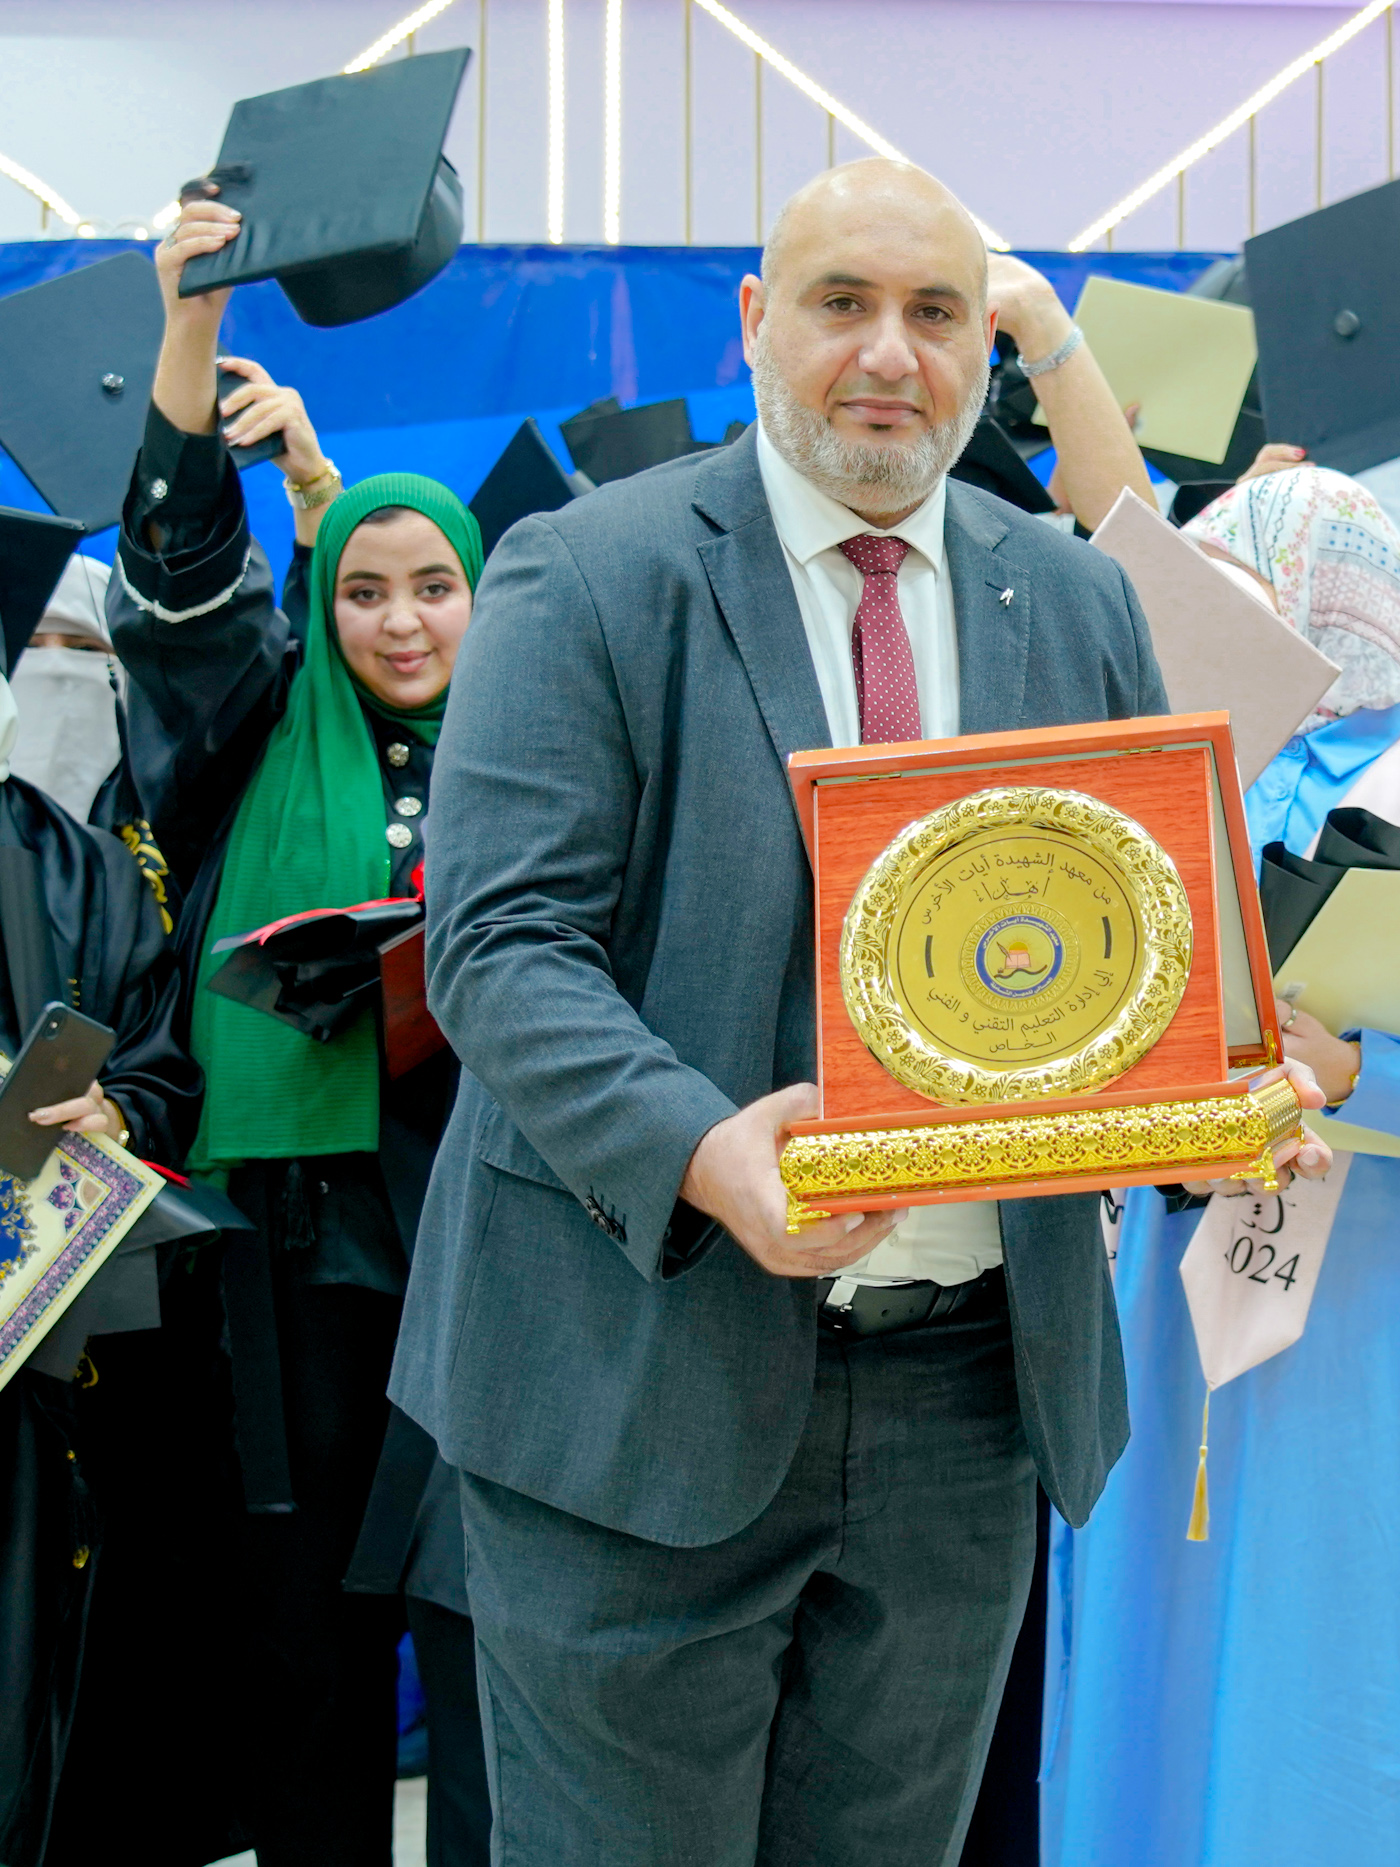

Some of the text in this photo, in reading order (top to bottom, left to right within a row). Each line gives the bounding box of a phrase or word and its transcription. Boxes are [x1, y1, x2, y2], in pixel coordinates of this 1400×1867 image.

[994, 852, 1055, 869] الشهيدة
[1060, 862, 1093, 886] معهد
[921, 879, 955, 925] الأخرس
[1093, 886, 1112, 905] من
[926, 989, 961, 1013] الفني
[1065, 986, 1100, 1012] إدارة
[959, 1012, 969, 1022] و
[973, 1018, 1014, 1034] التقني
[1020, 1007, 1066, 1036] التعليم
[989, 1031, 1057, 1053] الخاص
[1225, 1236, 1302, 1292] 024
